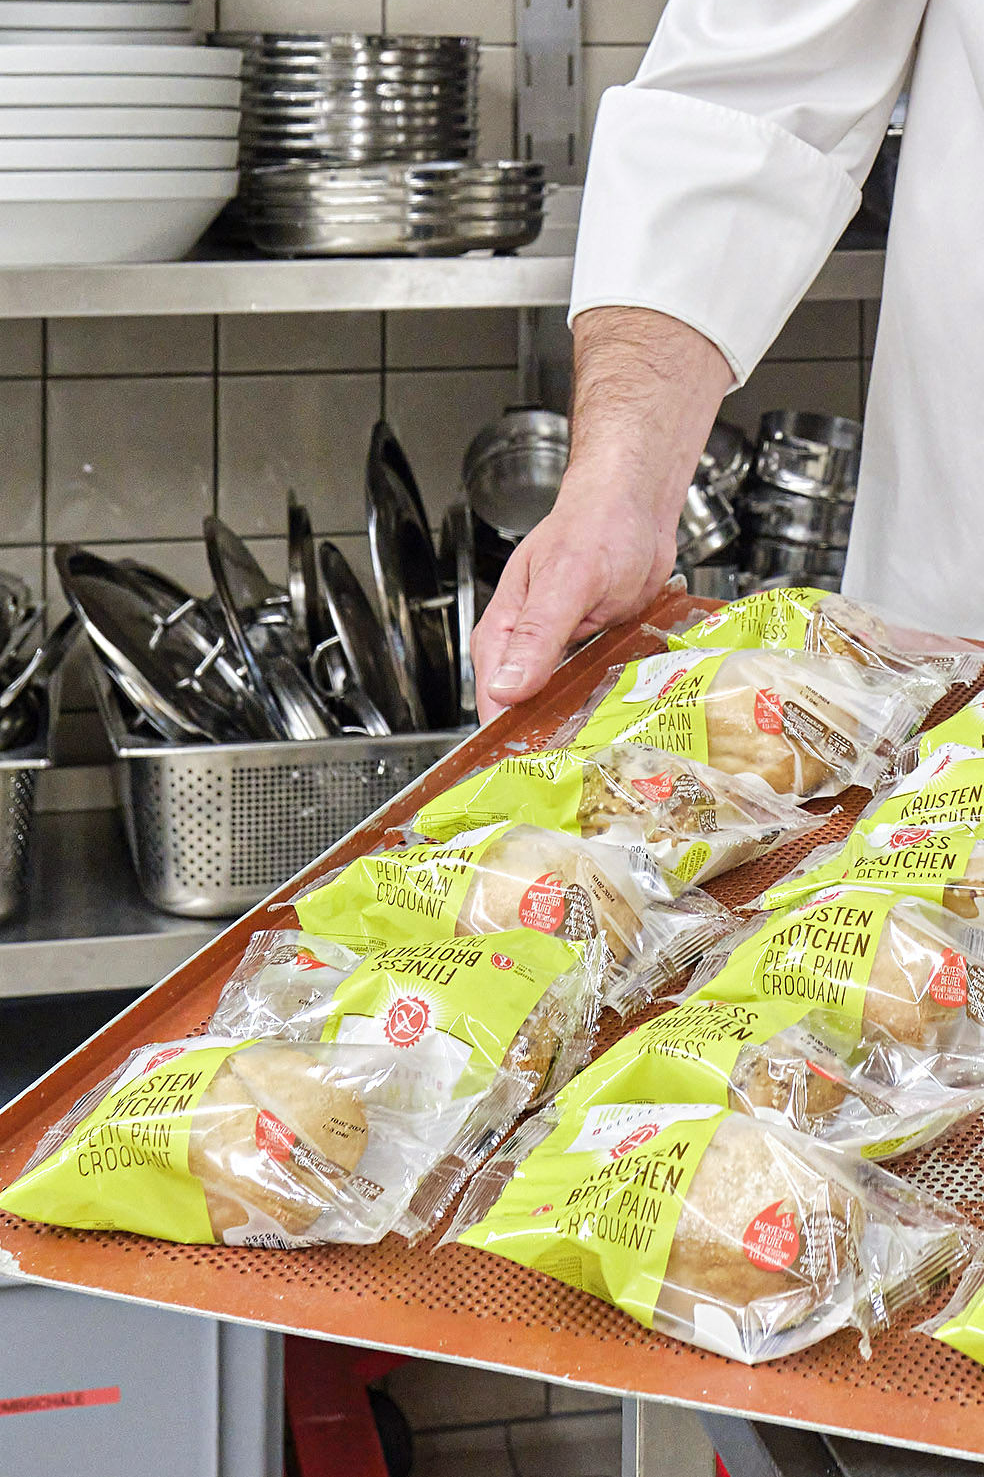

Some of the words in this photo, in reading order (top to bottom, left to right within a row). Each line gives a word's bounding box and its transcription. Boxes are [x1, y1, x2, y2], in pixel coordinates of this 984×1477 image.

[741, 618, 789, 640] FITNESS
[658, 712, 692, 732] PAIN
[376, 861, 414, 885] PETIT
[415, 869, 453, 898] PAIN
[376, 881, 446, 920] CROQUANT
[371, 959, 458, 986] FITNESS
[813, 954, 854, 981] PAIN
[674, 1005, 759, 1025] FITNESS
[131, 1123, 172, 1148] PAIN
[78, 1146, 174, 1177] CROQUANT
[617, 1189, 662, 1225] PAIN
[753, 1219, 796, 1243] BACKFESTER
[758, 1232, 783, 1249] BEUTEL
